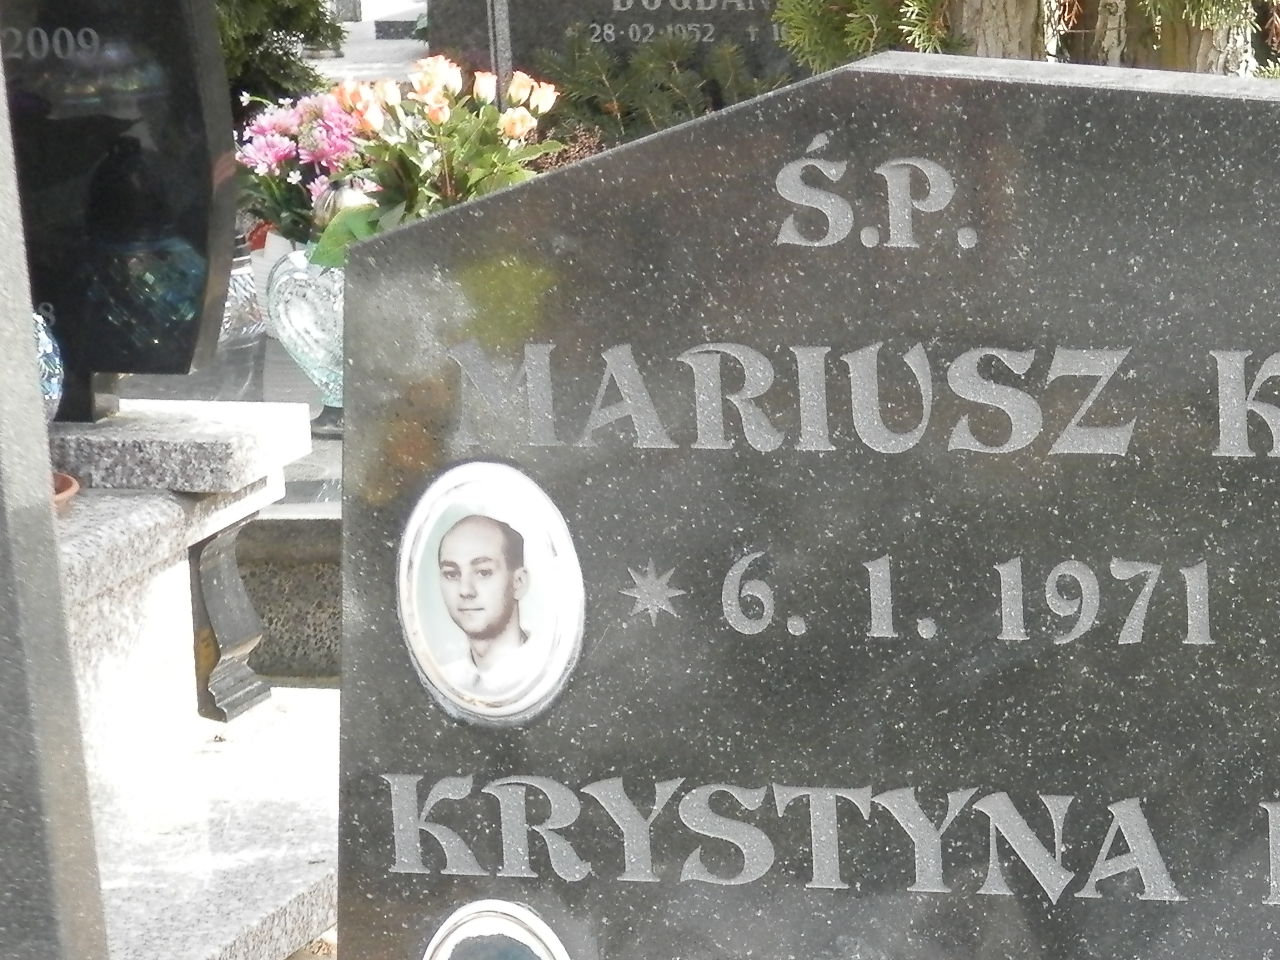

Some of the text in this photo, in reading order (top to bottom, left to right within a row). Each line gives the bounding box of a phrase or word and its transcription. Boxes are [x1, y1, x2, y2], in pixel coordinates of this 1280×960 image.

[774, 130, 979, 249] Ś.P.
[446, 340, 1138, 458] MARIUSZ
[720, 550, 808, 637] 6.
[862, 553, 939, 640] 1.
[994, 556, 1216, 647] 1971
[381, 771, 1188, 906] KRYSTYNA
